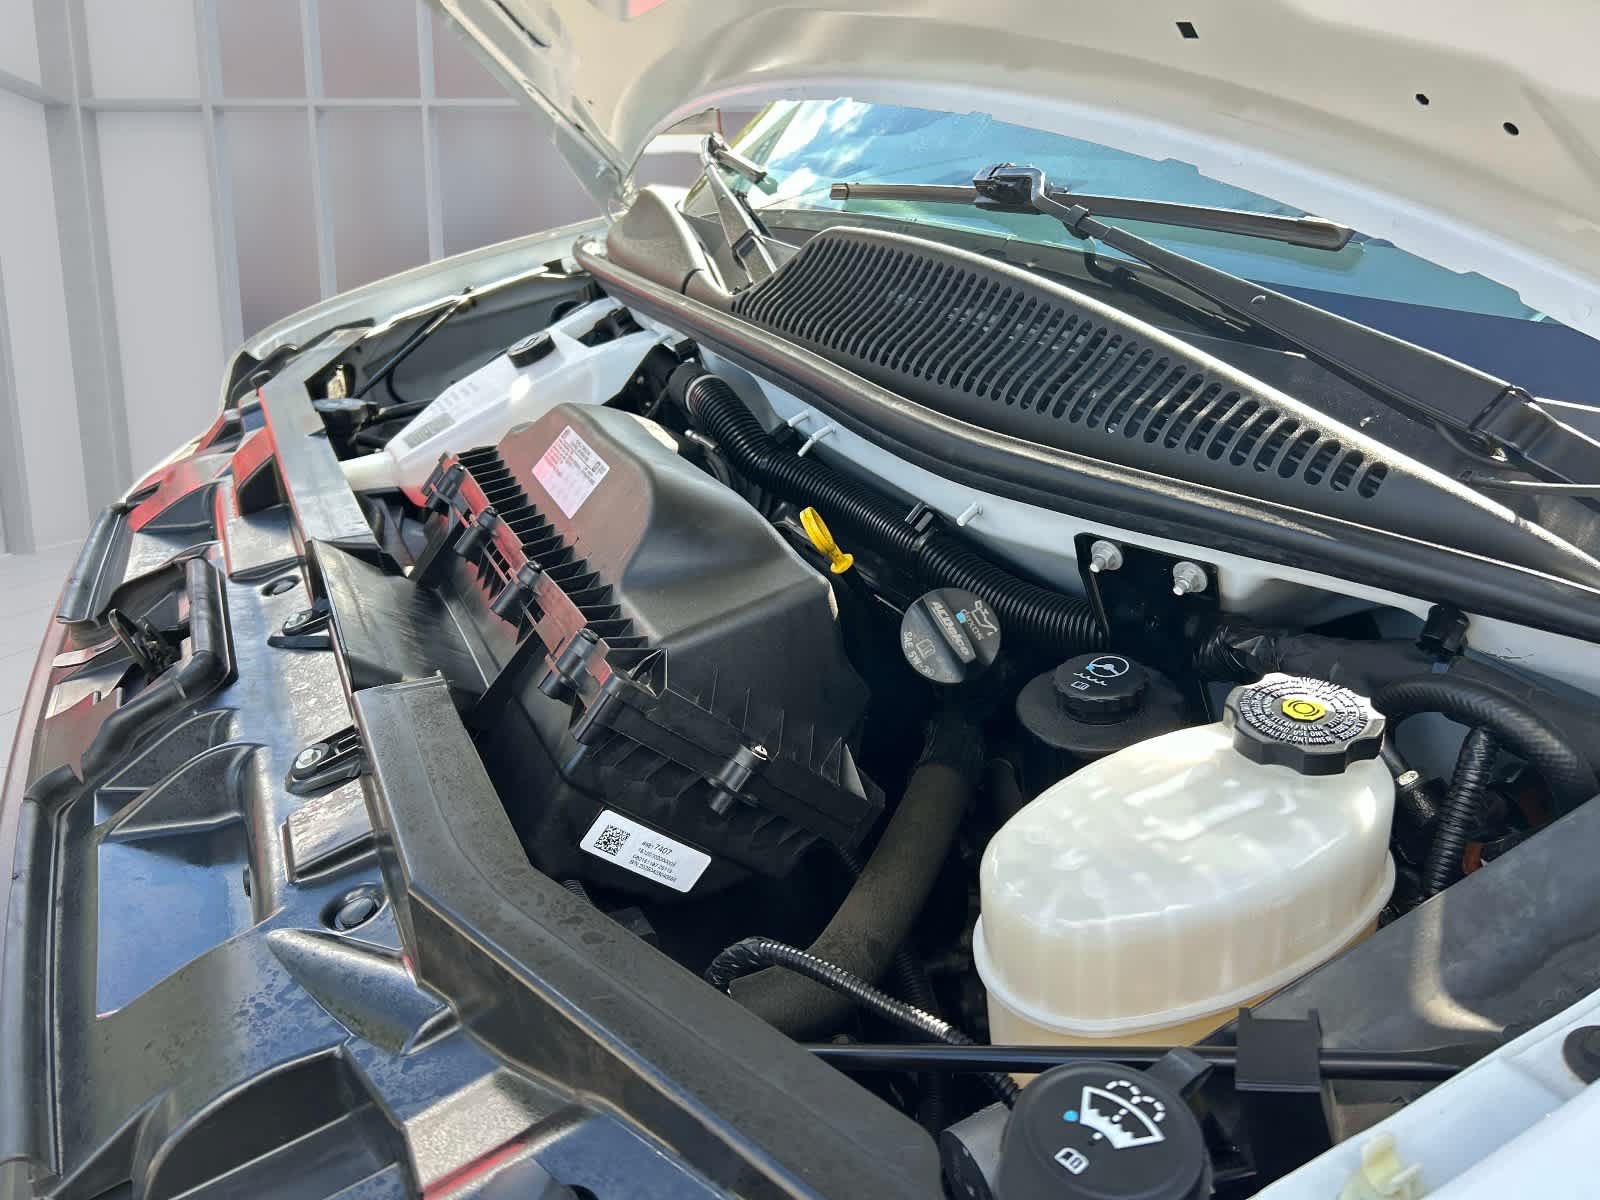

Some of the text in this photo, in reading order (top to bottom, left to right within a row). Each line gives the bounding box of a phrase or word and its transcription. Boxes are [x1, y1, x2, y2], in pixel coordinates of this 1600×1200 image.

[931, 602, 970, 656] ACDelco
[904, 632, 935, 677] SAE 5W-30
[1259, 724, 1287, 739] SEALED
[1271, 715, 1323, 732] CLEAN FILLER
[1294, 729, 1309, 737] USE
[1310, 729, 1330, 737] ONLY
[655, 843, 673, 855] 7407
